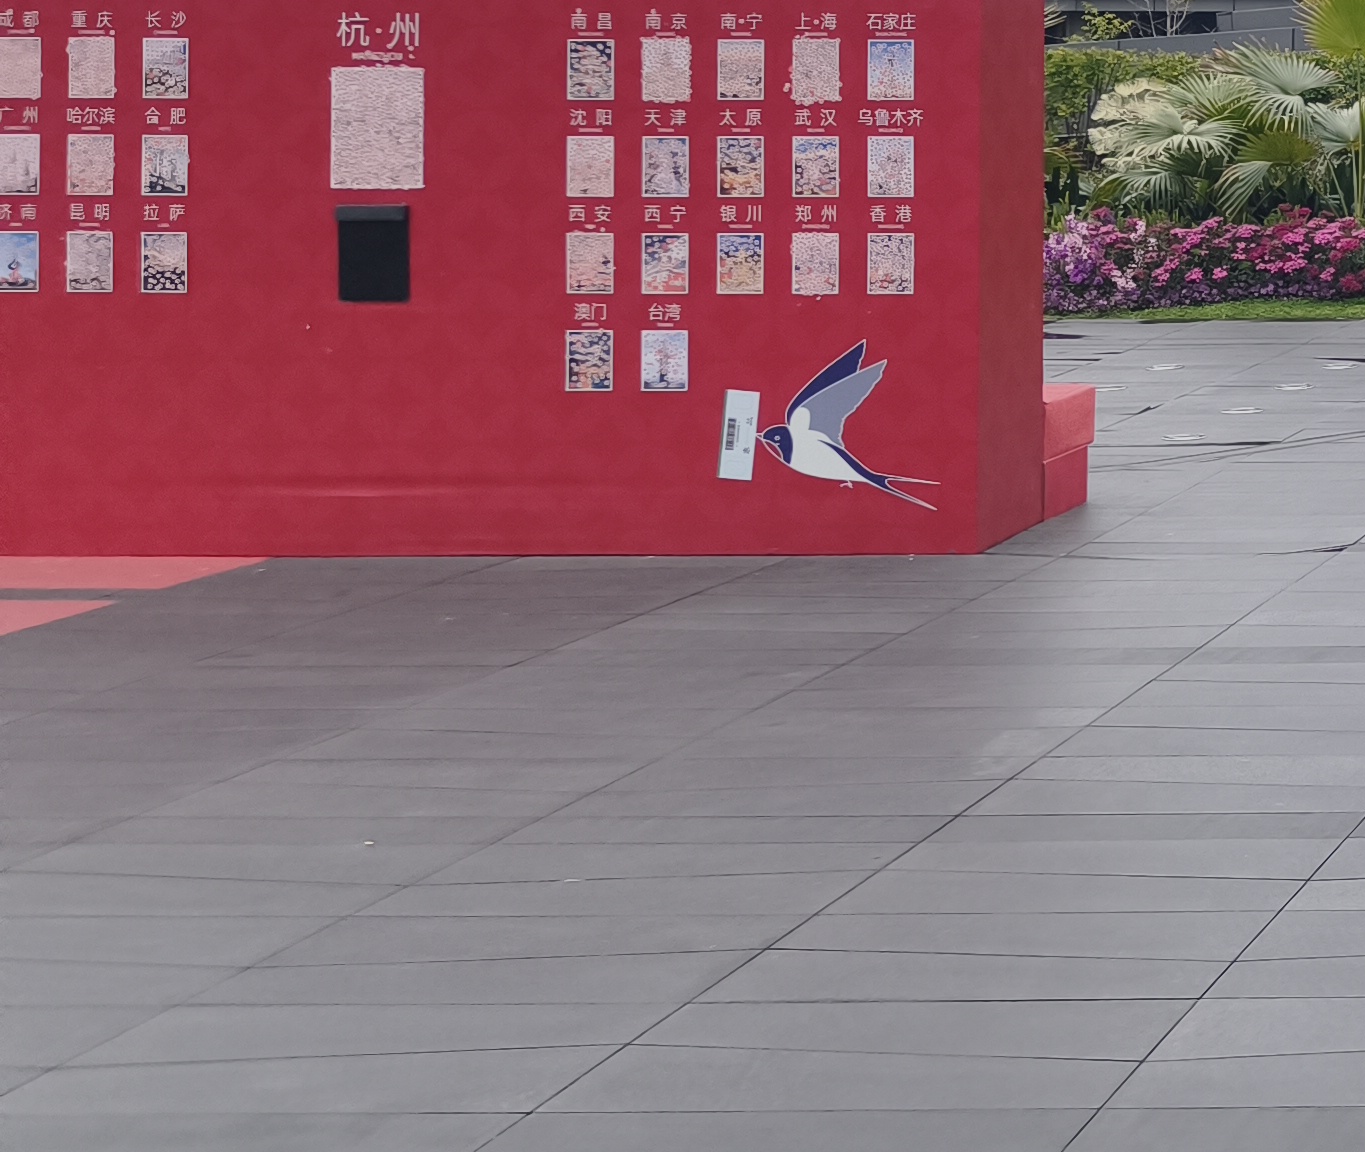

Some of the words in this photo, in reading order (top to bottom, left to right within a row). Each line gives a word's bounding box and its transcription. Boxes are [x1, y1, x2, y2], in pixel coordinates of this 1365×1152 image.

[71, 10, 113, 28] 重庆
[145, 10, 187, 28] 长沙
[570, 12, 612, 30] 南昌
[645, 12, 687, 30] 南京
[866, 12, 917, 30] 石家庄
[67, 106, 116, 125] 哈尔滨
[144, 106, 187, 125] 合肥
[570, 108, 613, 126] 沈阳
[644, 108, 687, 126] 天津
[719, 108, 762, 126] 太原
[795, 108, 837, 127] 武汉
[858, 108, 924, 127] 乌鲁木齐
[70, 203, 110, 221] 昆明
[143, 203, 186, 221] 拉萨
[569, 204, 612, 223] 西安
[644, 204, 687, 223] 西宁
[720, 204, 762, 223] 银川
[795, 204, 837, 223] 郑州
[870, 204, 912, 223] 香港
[574, 302, 607, 321] 澳门
[648, 302, 682, 321] 台湾
